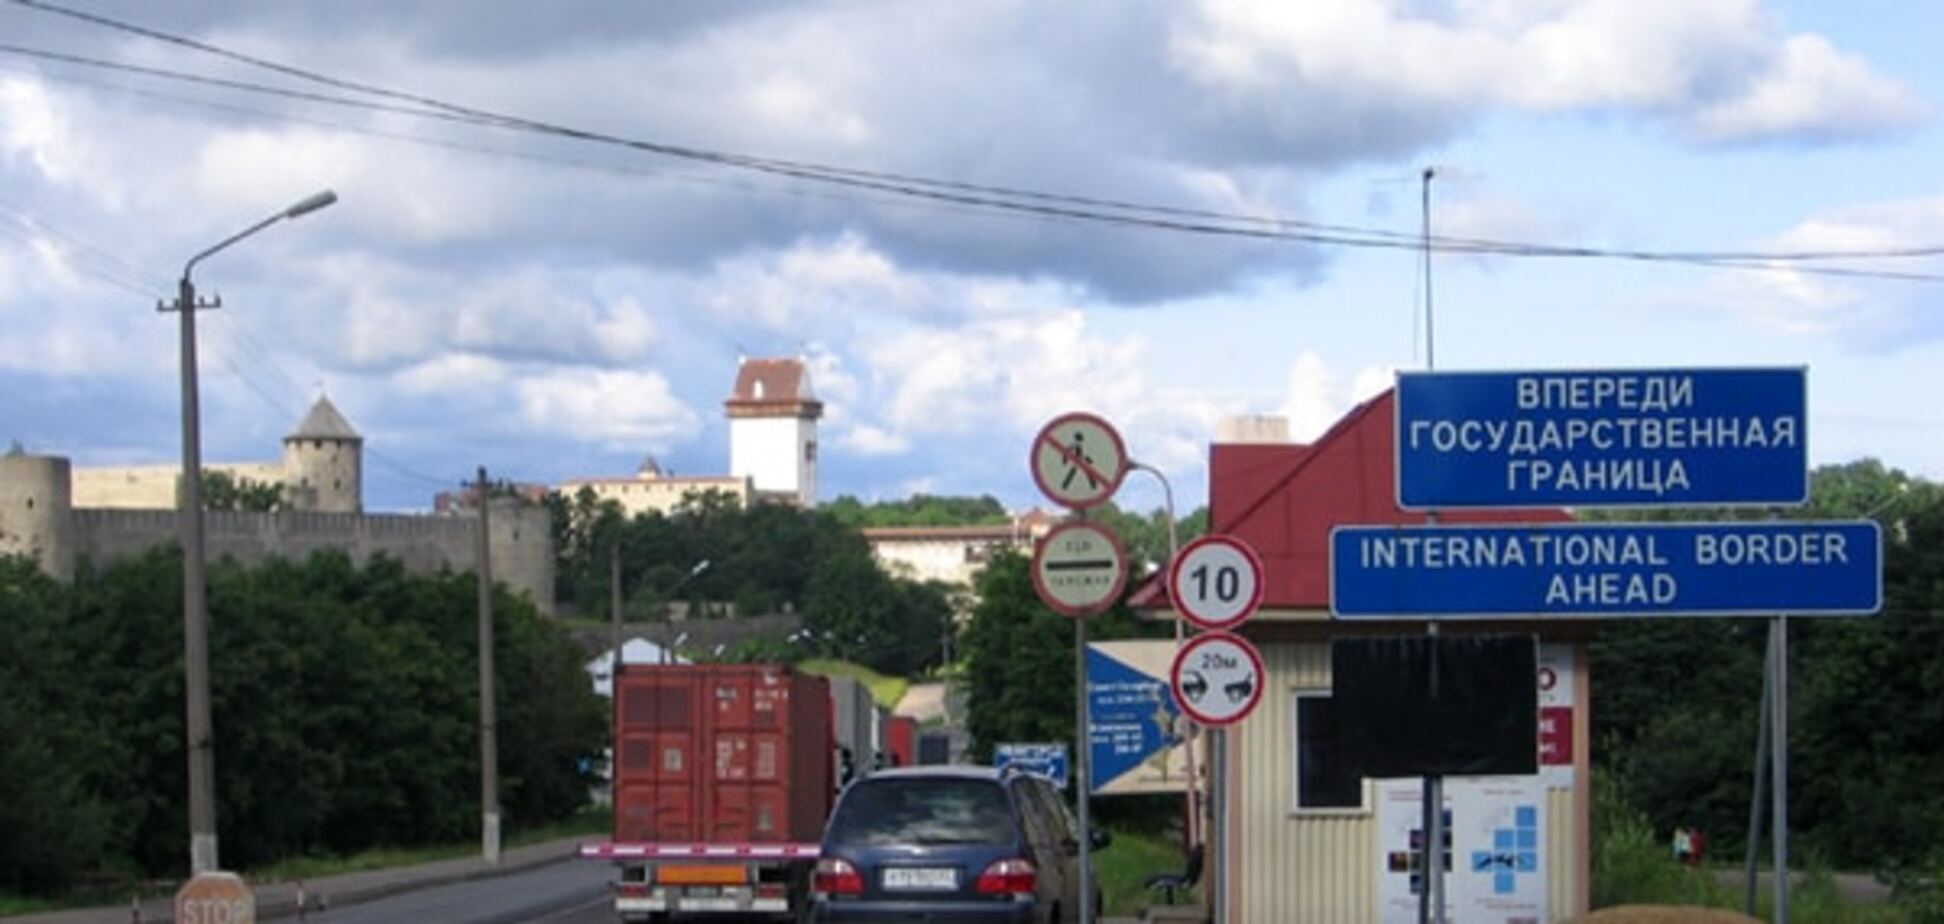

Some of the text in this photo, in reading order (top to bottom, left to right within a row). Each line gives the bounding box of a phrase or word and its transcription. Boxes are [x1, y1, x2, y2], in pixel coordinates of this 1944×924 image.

[1517, 376, 1693, 412] ВПЕРЕДИ
[1410, 417, 1796, 454] ГОСУДАРСТВЕННАЯ
[1507, 460, 1690, 495] ГРАНИЦА
[1360, 533, 1848, 569] INTERNATIONAL BORDER
[1190, 565, 1240, 603] 10
[1546, 574, 1677, 606] AHEAD
